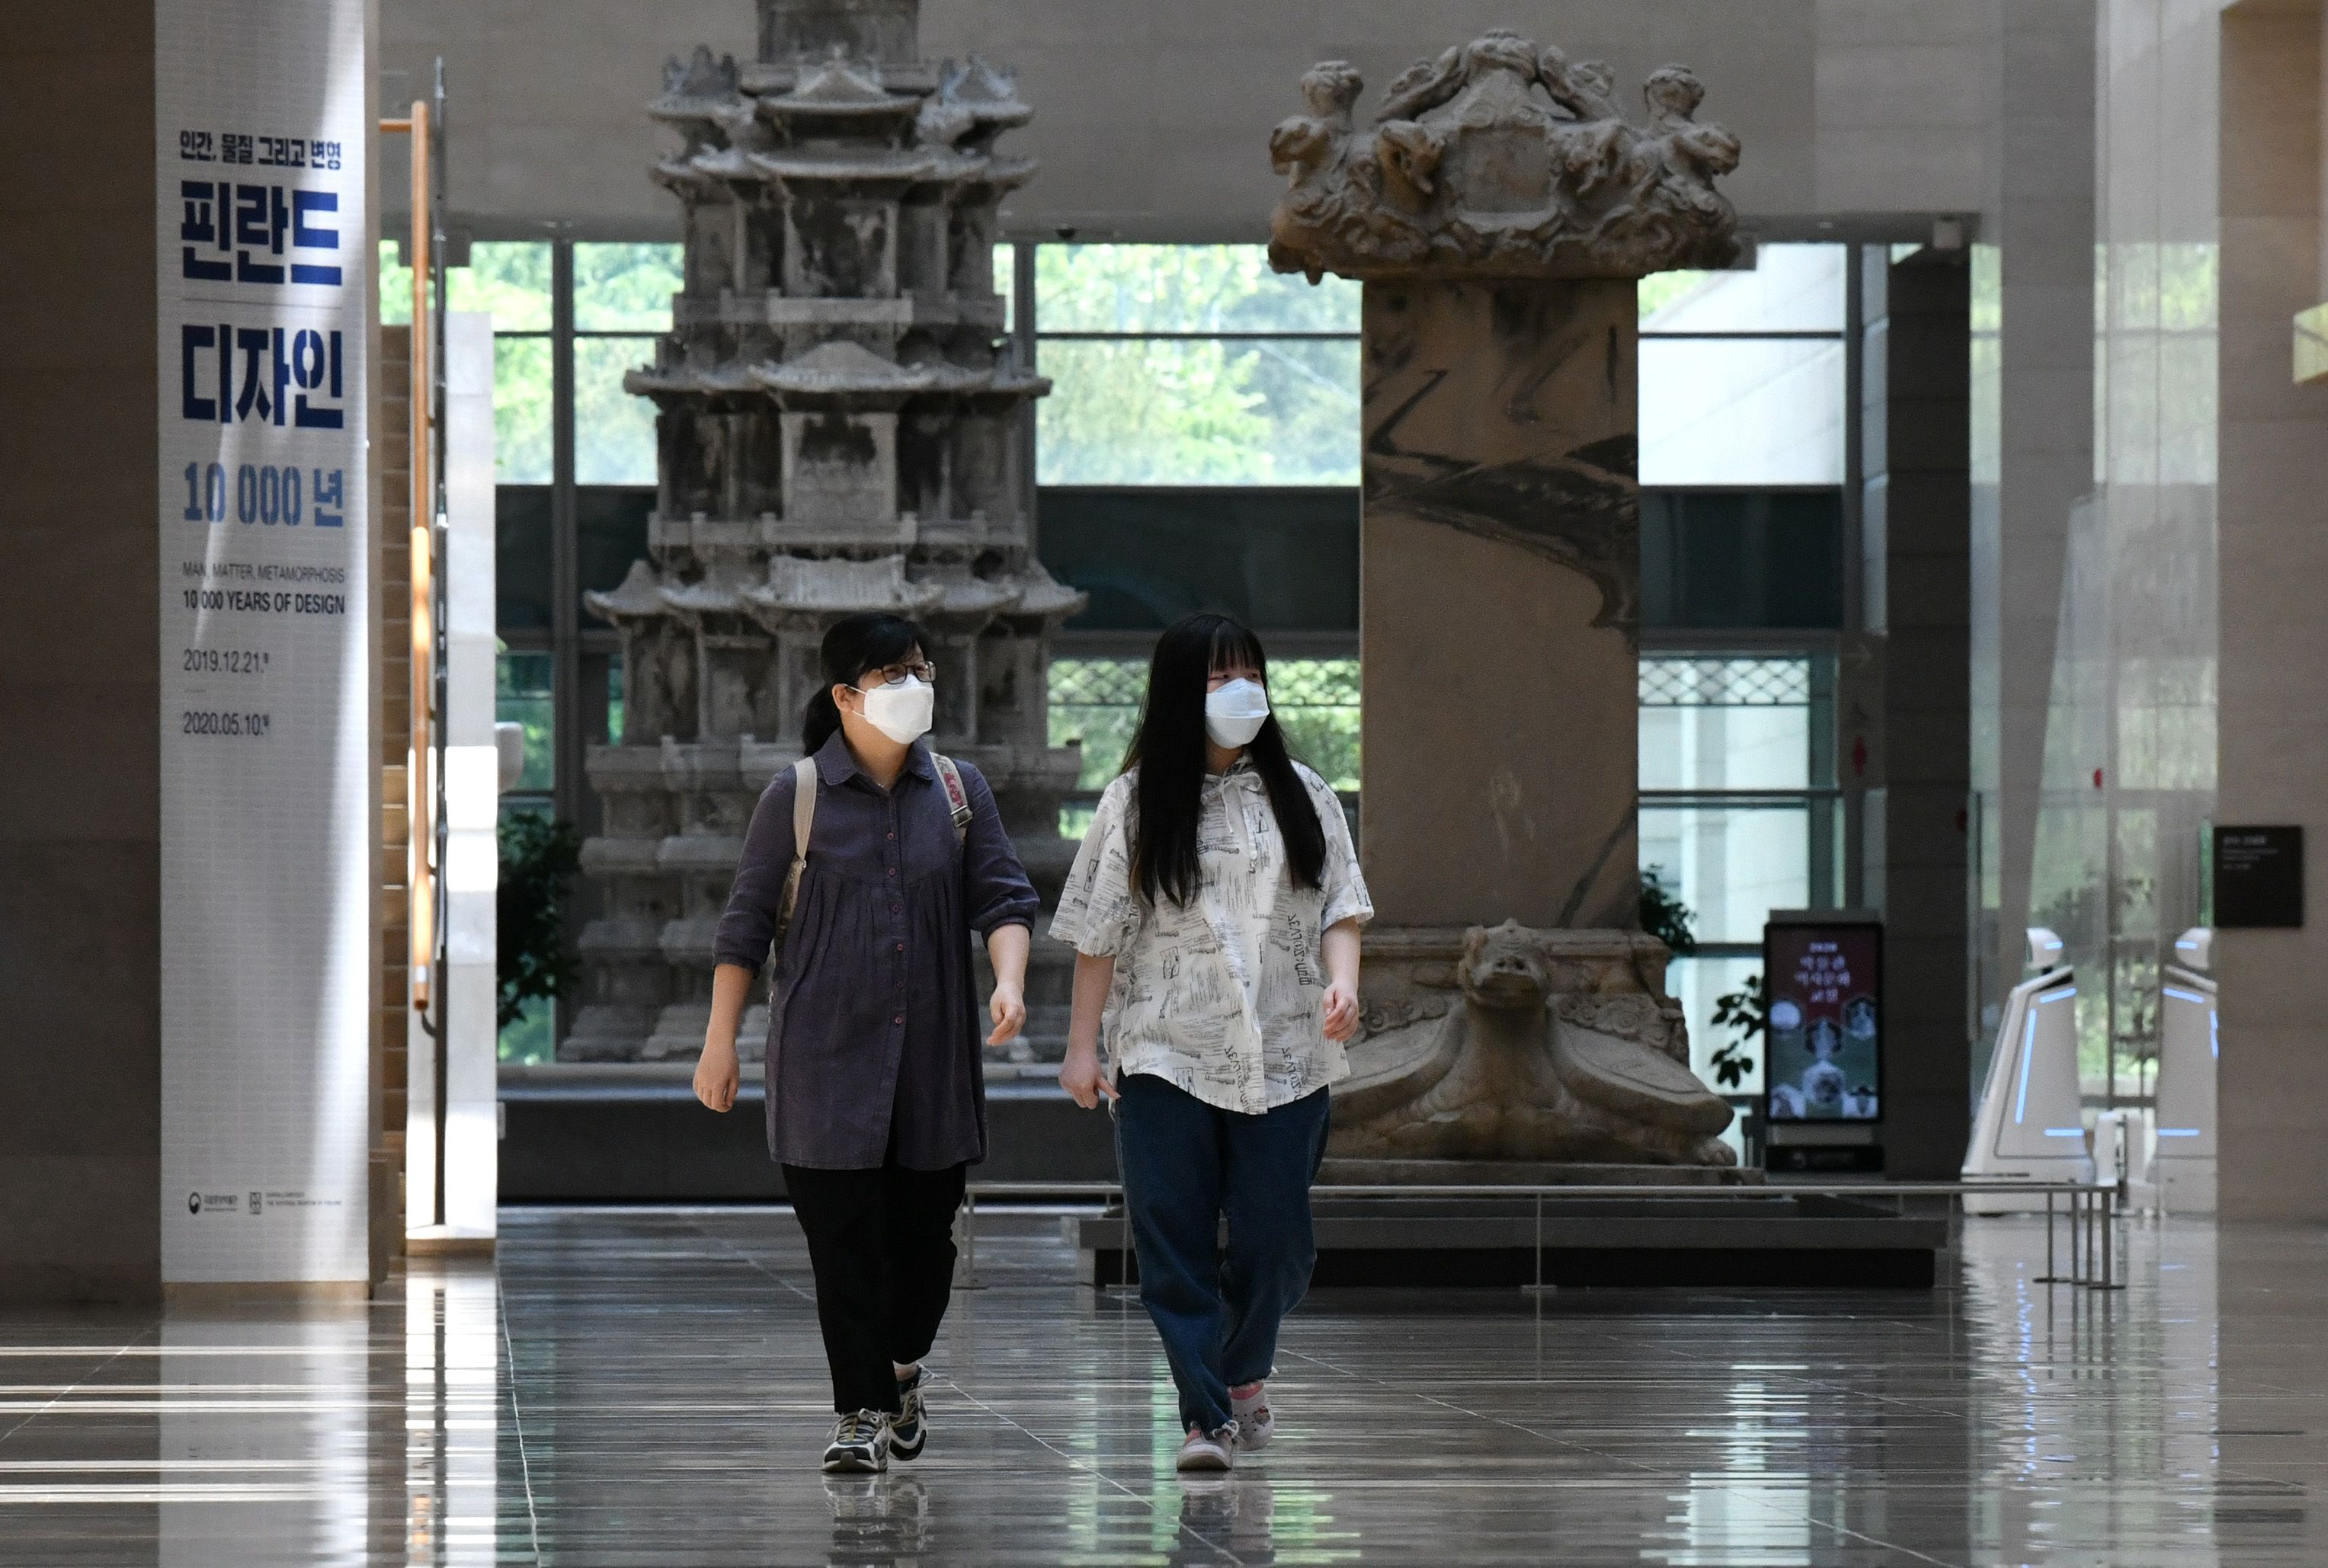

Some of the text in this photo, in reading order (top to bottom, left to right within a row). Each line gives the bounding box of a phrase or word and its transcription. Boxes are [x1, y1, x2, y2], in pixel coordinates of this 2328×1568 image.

[222, 133, 253, 164] 물질
[258, 136, 306, 167] 그리고
[181, 180, 342, 286] 핀란드
[182, 324, 344, 429] 디자인
[314, 468, 343, 526] 년
[227, 591, 271, 612] YEARS
[274, 593, 292, 613] OF
[295, 594, 345, 614] DESIGN
